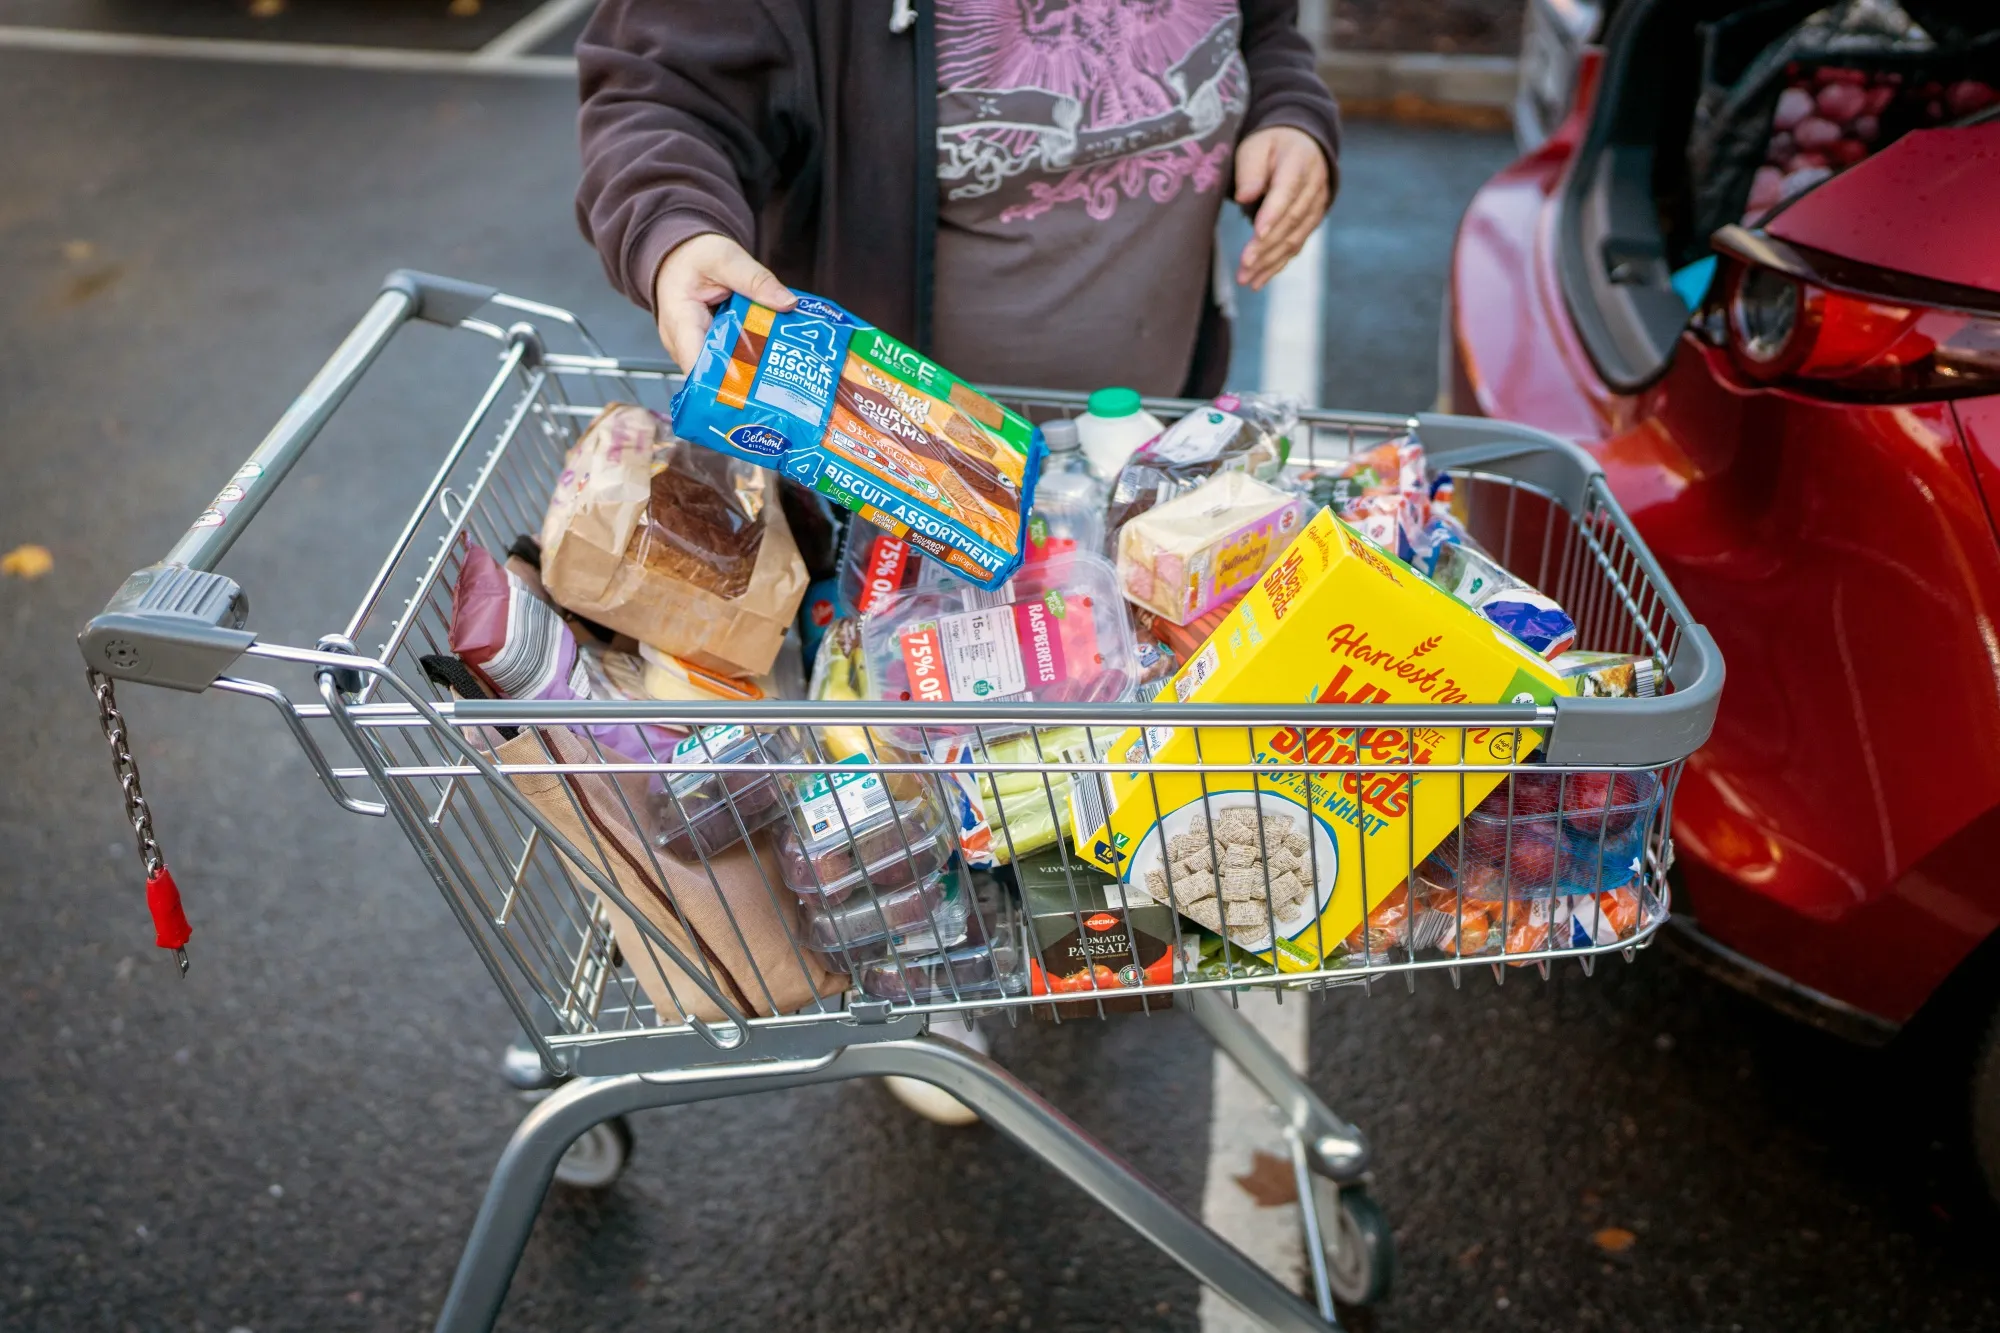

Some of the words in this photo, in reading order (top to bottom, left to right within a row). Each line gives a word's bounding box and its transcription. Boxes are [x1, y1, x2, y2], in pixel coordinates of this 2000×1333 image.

[771, 341, 835, 378] PACK
[874, 335, 937, 379] NICE
[764, 365, 830, 399] ASSORTMENT
[767, 351, 833, 390] BISCUIT
[742, 429, 783, 451] Belmont
[829, 483, 854, 505] NICE
[824, 464, 892, 508] BISCUIT
[892, 504, 1004, 573] ASSORTMENT
[912, 532, 946, 552] BOURBON
[912, 537, 941, 555] CREAMS
[876, 540, 902, 576] 75%
[950, 553, 990, 578] SHORTCAKE
[972, 616, 984, 629] 15
[909, 633, 936, 676] 75%
[1027, 603, 1056, 682] RASPBERRIES
[1327, 623, 1446, 693] Harvest
[919, 677, 943, 701] OF
[1293, 785, 1323, 806] GRIN
[1323, 791, 1389, 837] WHEAT
[1040, 864, 1083, 874] PASATA
[1068, 942, 1133, 957] PASSATA
[1076, 934, 1126, 946] TOMATO
